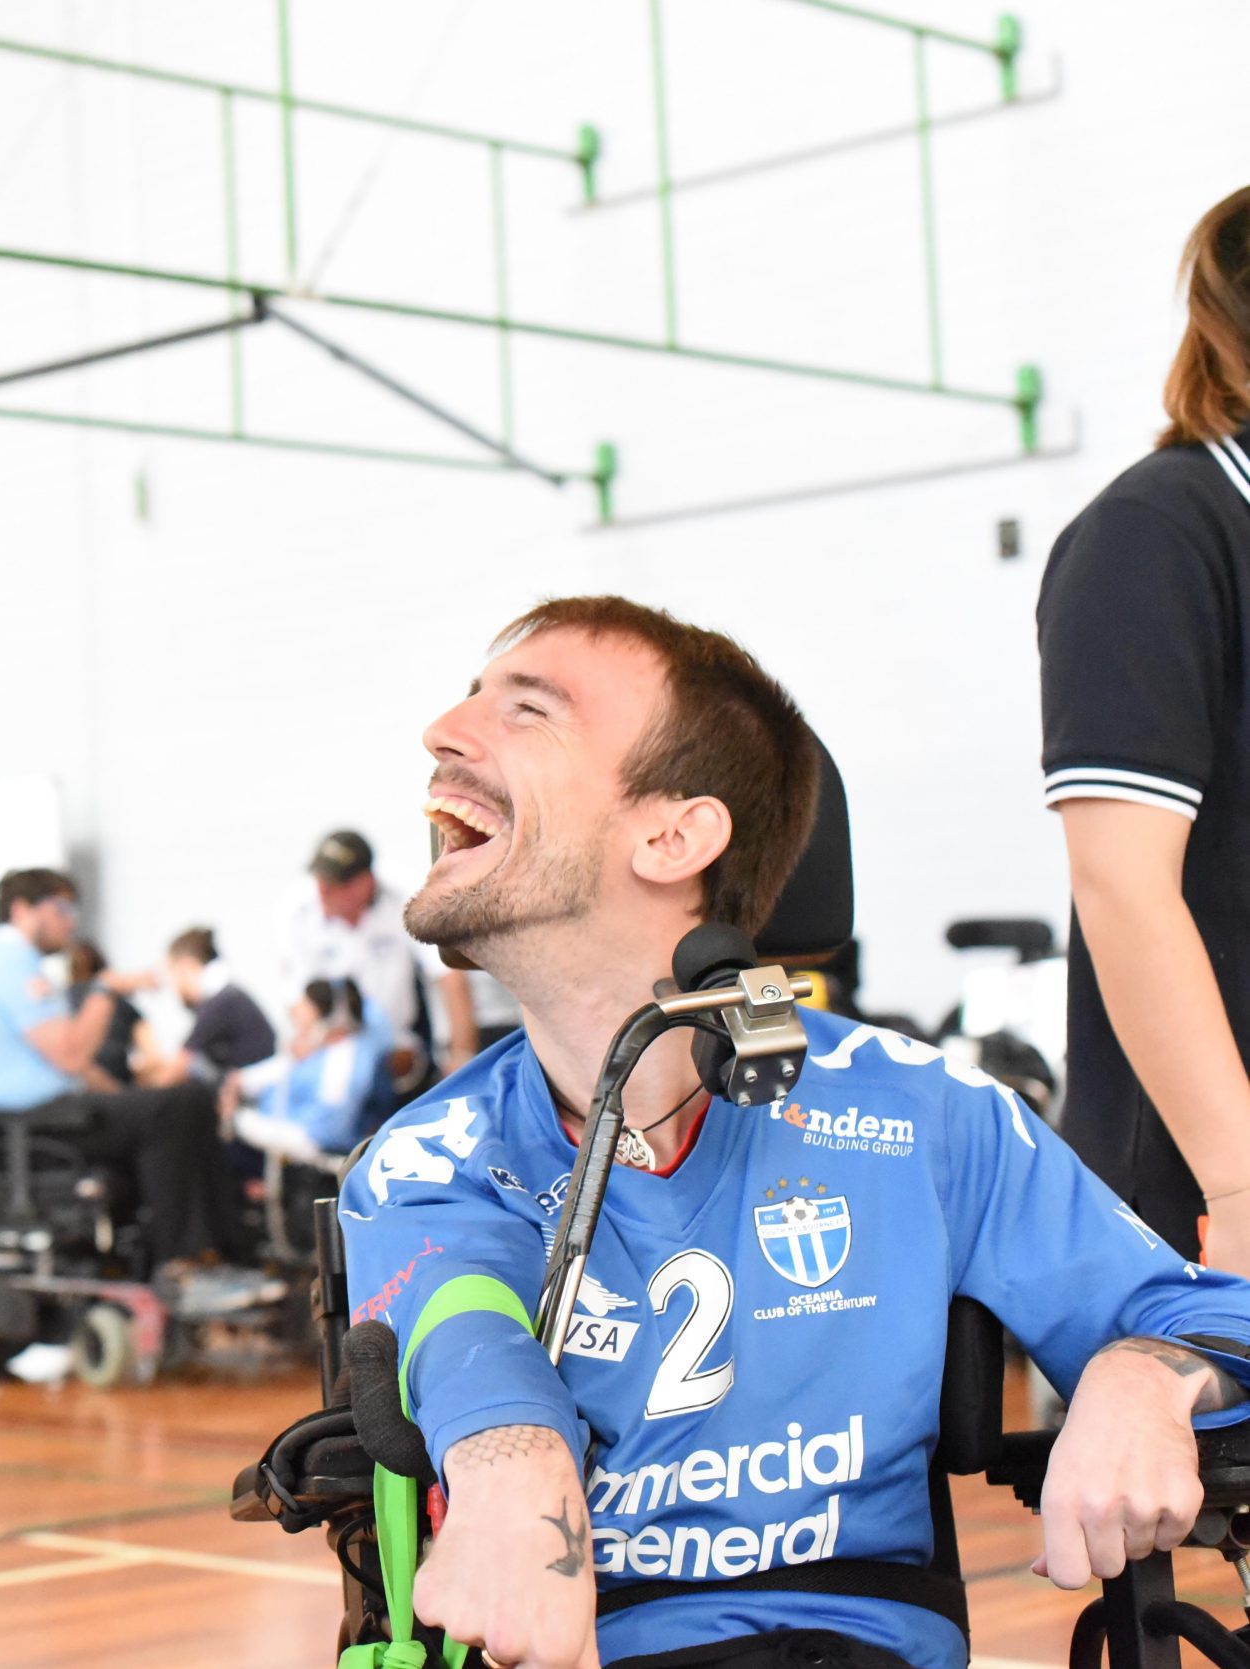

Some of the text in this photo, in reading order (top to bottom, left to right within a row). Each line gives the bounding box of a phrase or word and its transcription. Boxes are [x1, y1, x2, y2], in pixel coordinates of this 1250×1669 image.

[802, 1131, 914, 1158] BUILDING GROUP
[753, 1295, 877, 1320] CLUB OF THE CENTURY
[788, 1289, 843, 1307] OCEANIA
[644, 1248, 734, 1421] 2
[591, 1493, 840, 1578] General
